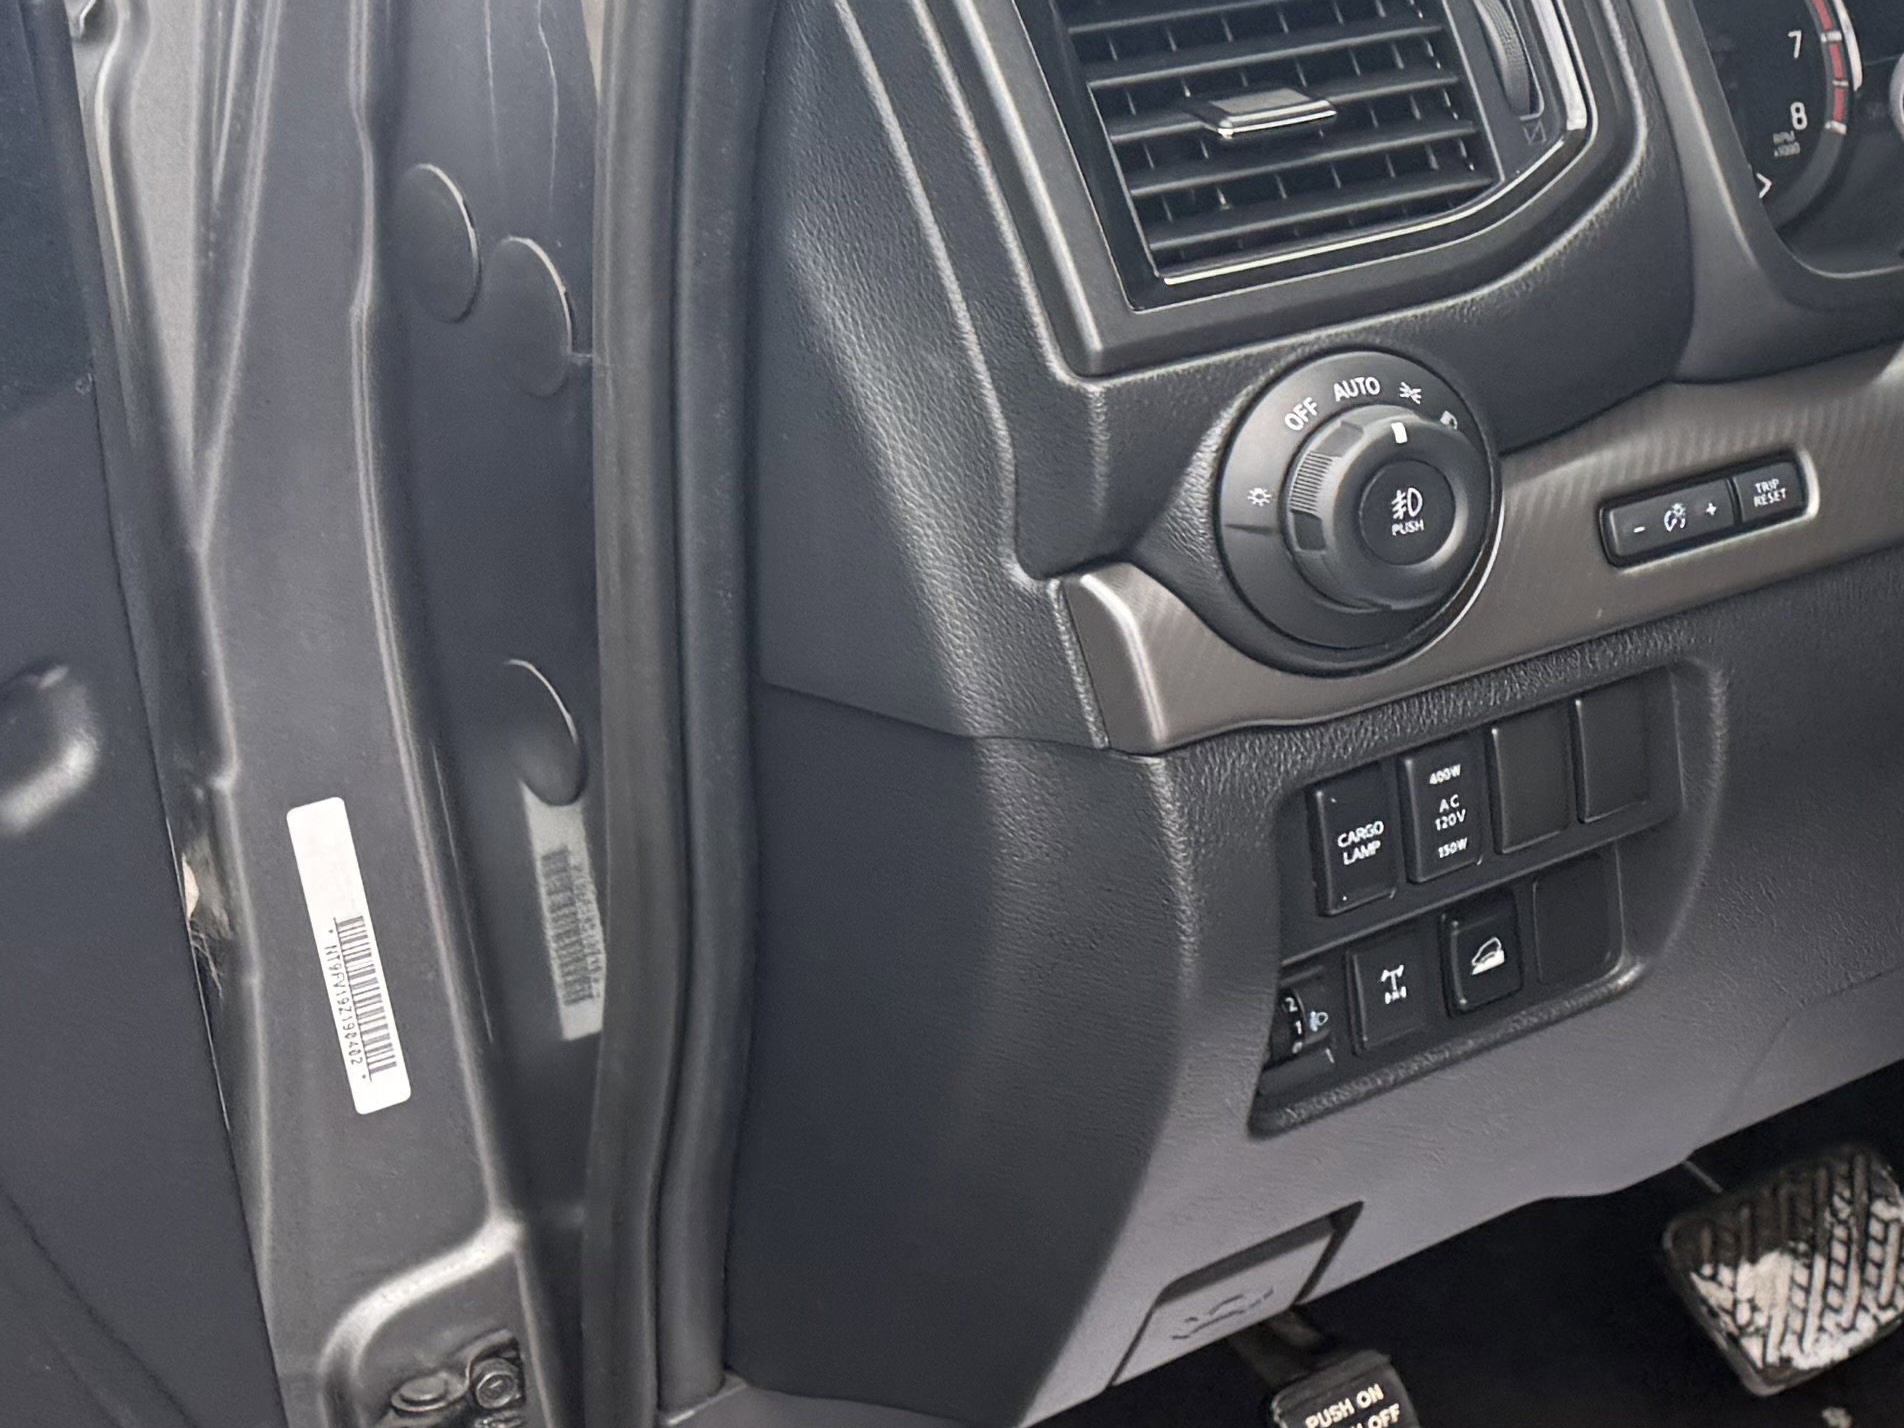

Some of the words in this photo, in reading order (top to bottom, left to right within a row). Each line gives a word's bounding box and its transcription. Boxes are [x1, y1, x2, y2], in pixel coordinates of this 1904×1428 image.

[1788, 29, 1802, 59] 7
[1790, 101, 1808, 131] 8
[1333, 376, 1381, 402] AUTO
[1284, 396, 1318, 432] OFF
[1753, 487, 1787, 508] RESET
[1754, 478, 1781, 494] TRIP
[1391, 519, 1425, 536] PUSH
[1429, 763, 1462, 785] 400W
[1434, 808, 1467, 832] 120V
[1337, 820, 1385, 849] CARGO
[1342, 839, 1382, 866] LAMP
[1438, 837, 1468, 859] 150W
[1284, 996, 1299, 1013] 2
[1294, 1020, 1302, 1035] 1
[1356, 1382, 1385, 1409] ON
